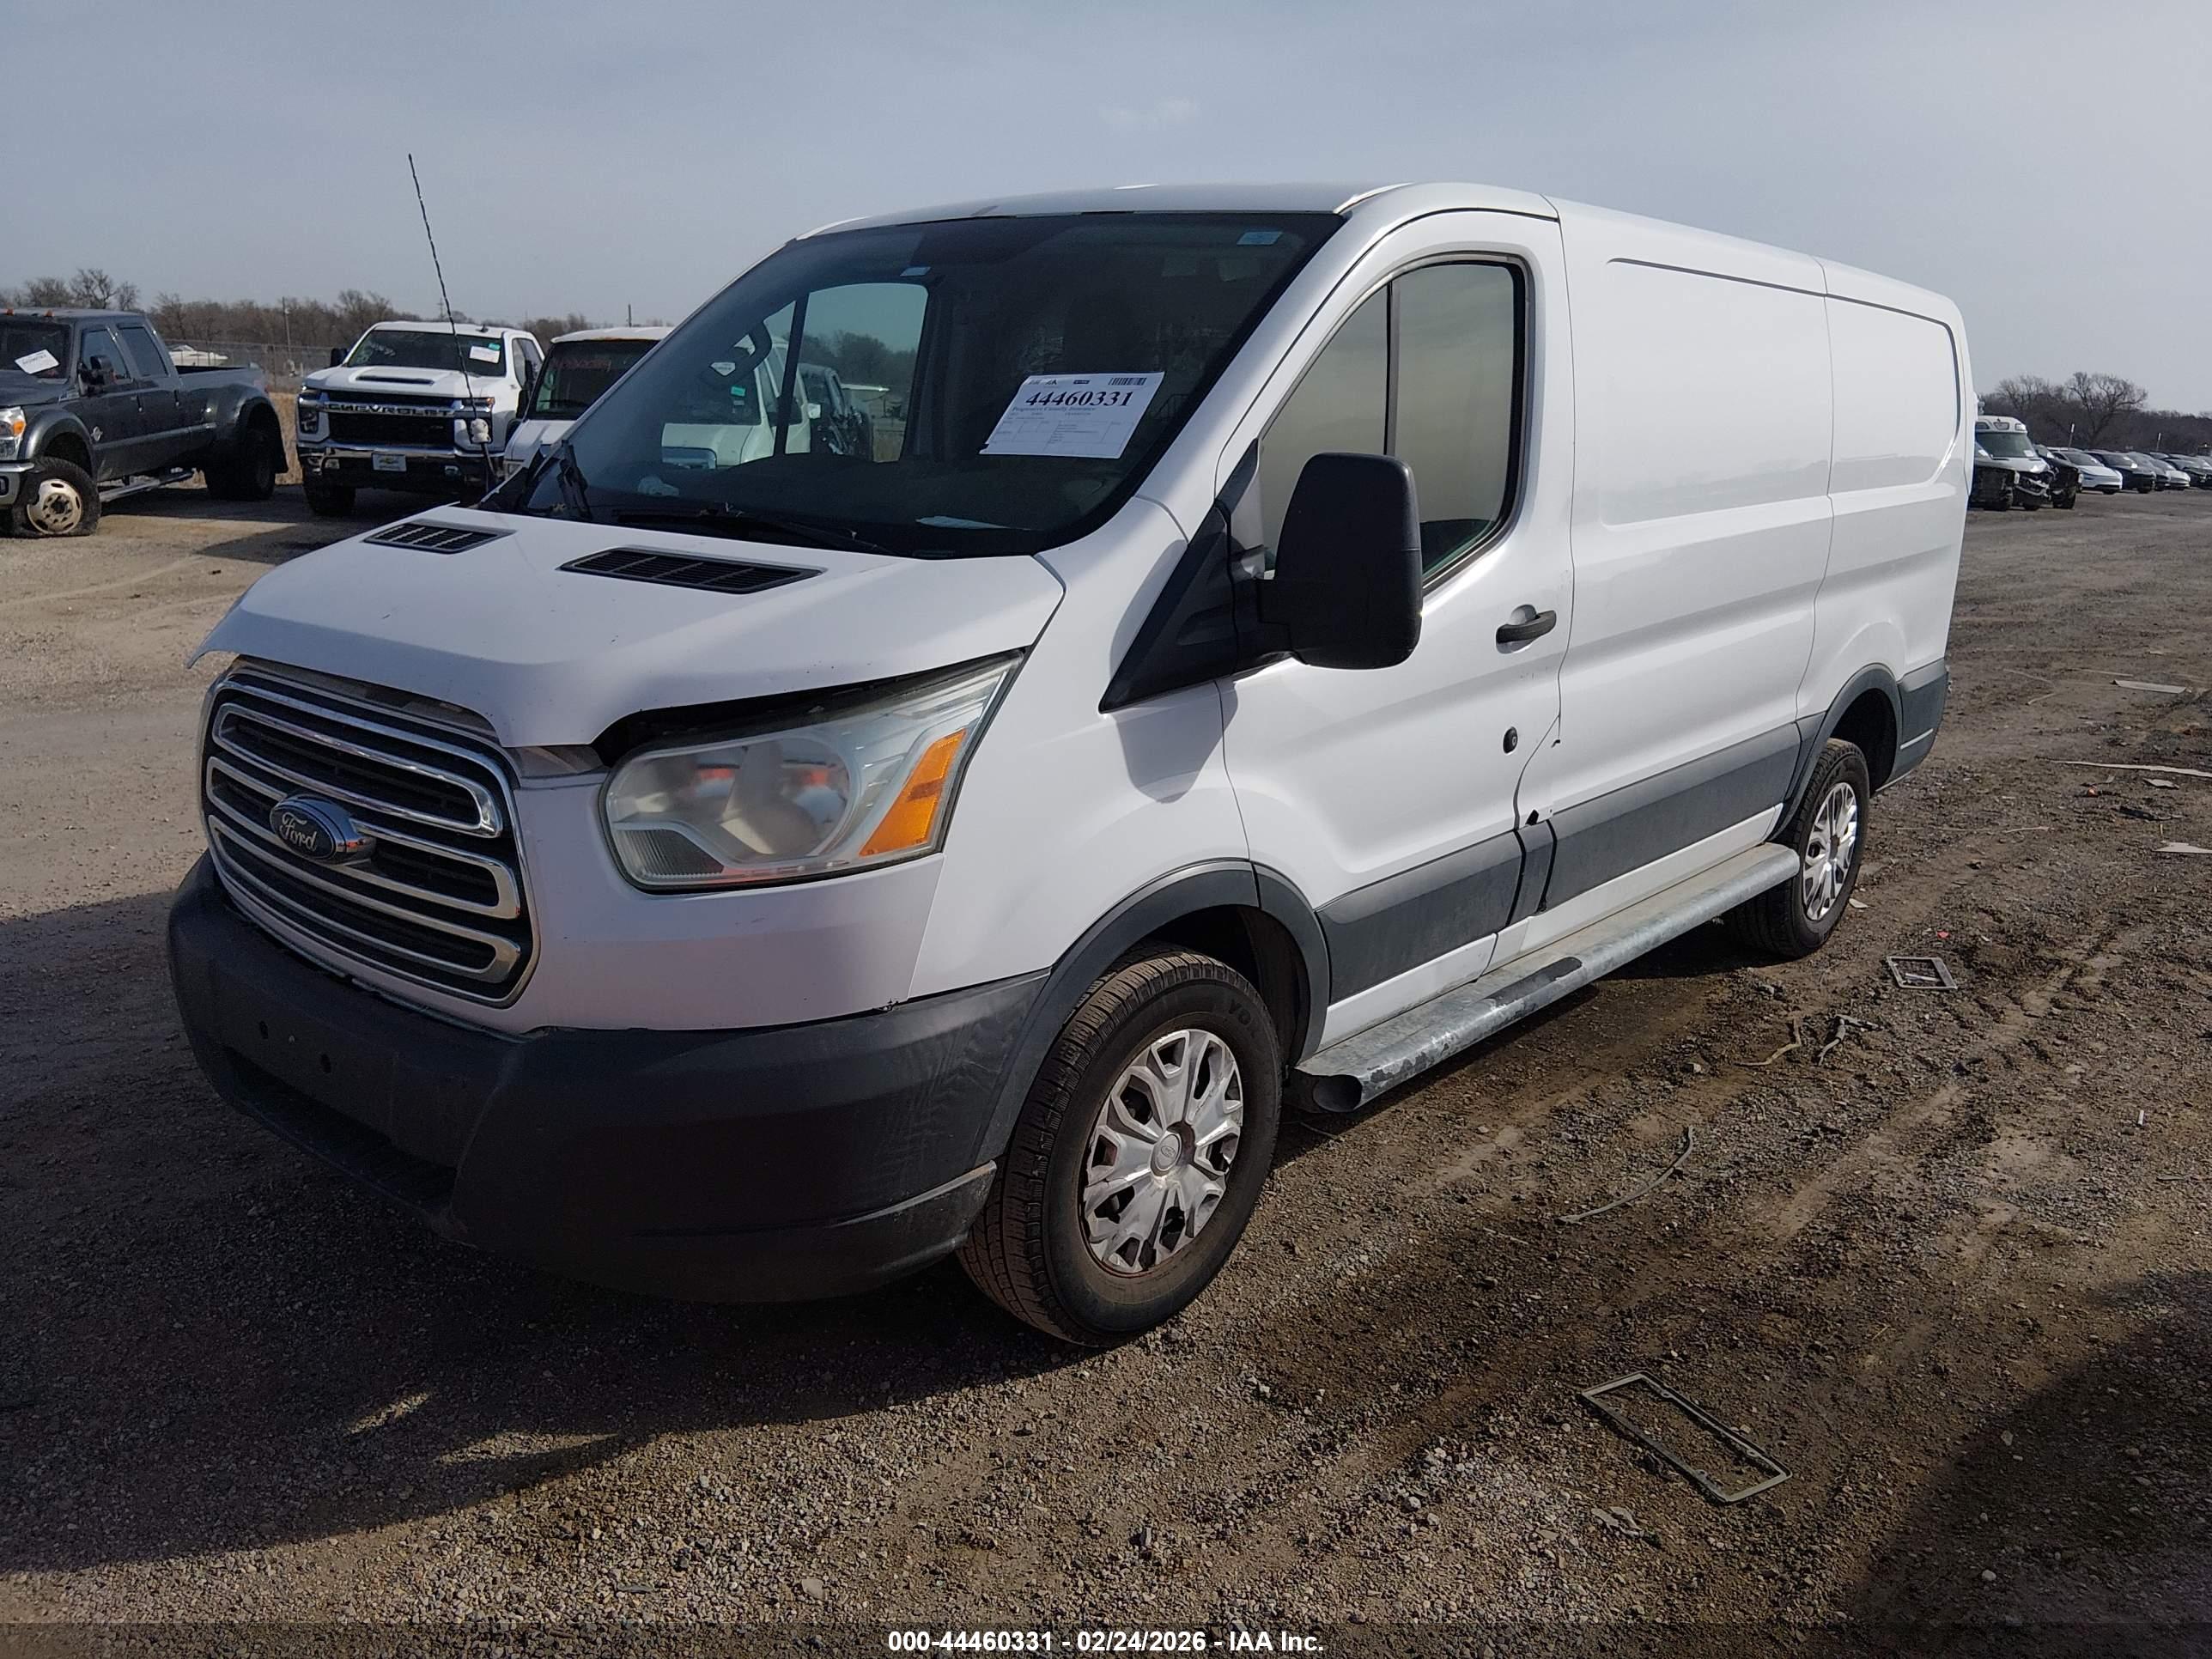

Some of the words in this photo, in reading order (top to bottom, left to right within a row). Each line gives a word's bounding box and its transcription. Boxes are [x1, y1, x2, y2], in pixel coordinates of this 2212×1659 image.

[1025, 391, 1133, 406] 44460331
[327, 403, 455, 417] CHEVROLET
[279, 811, 317, 852] Ford
